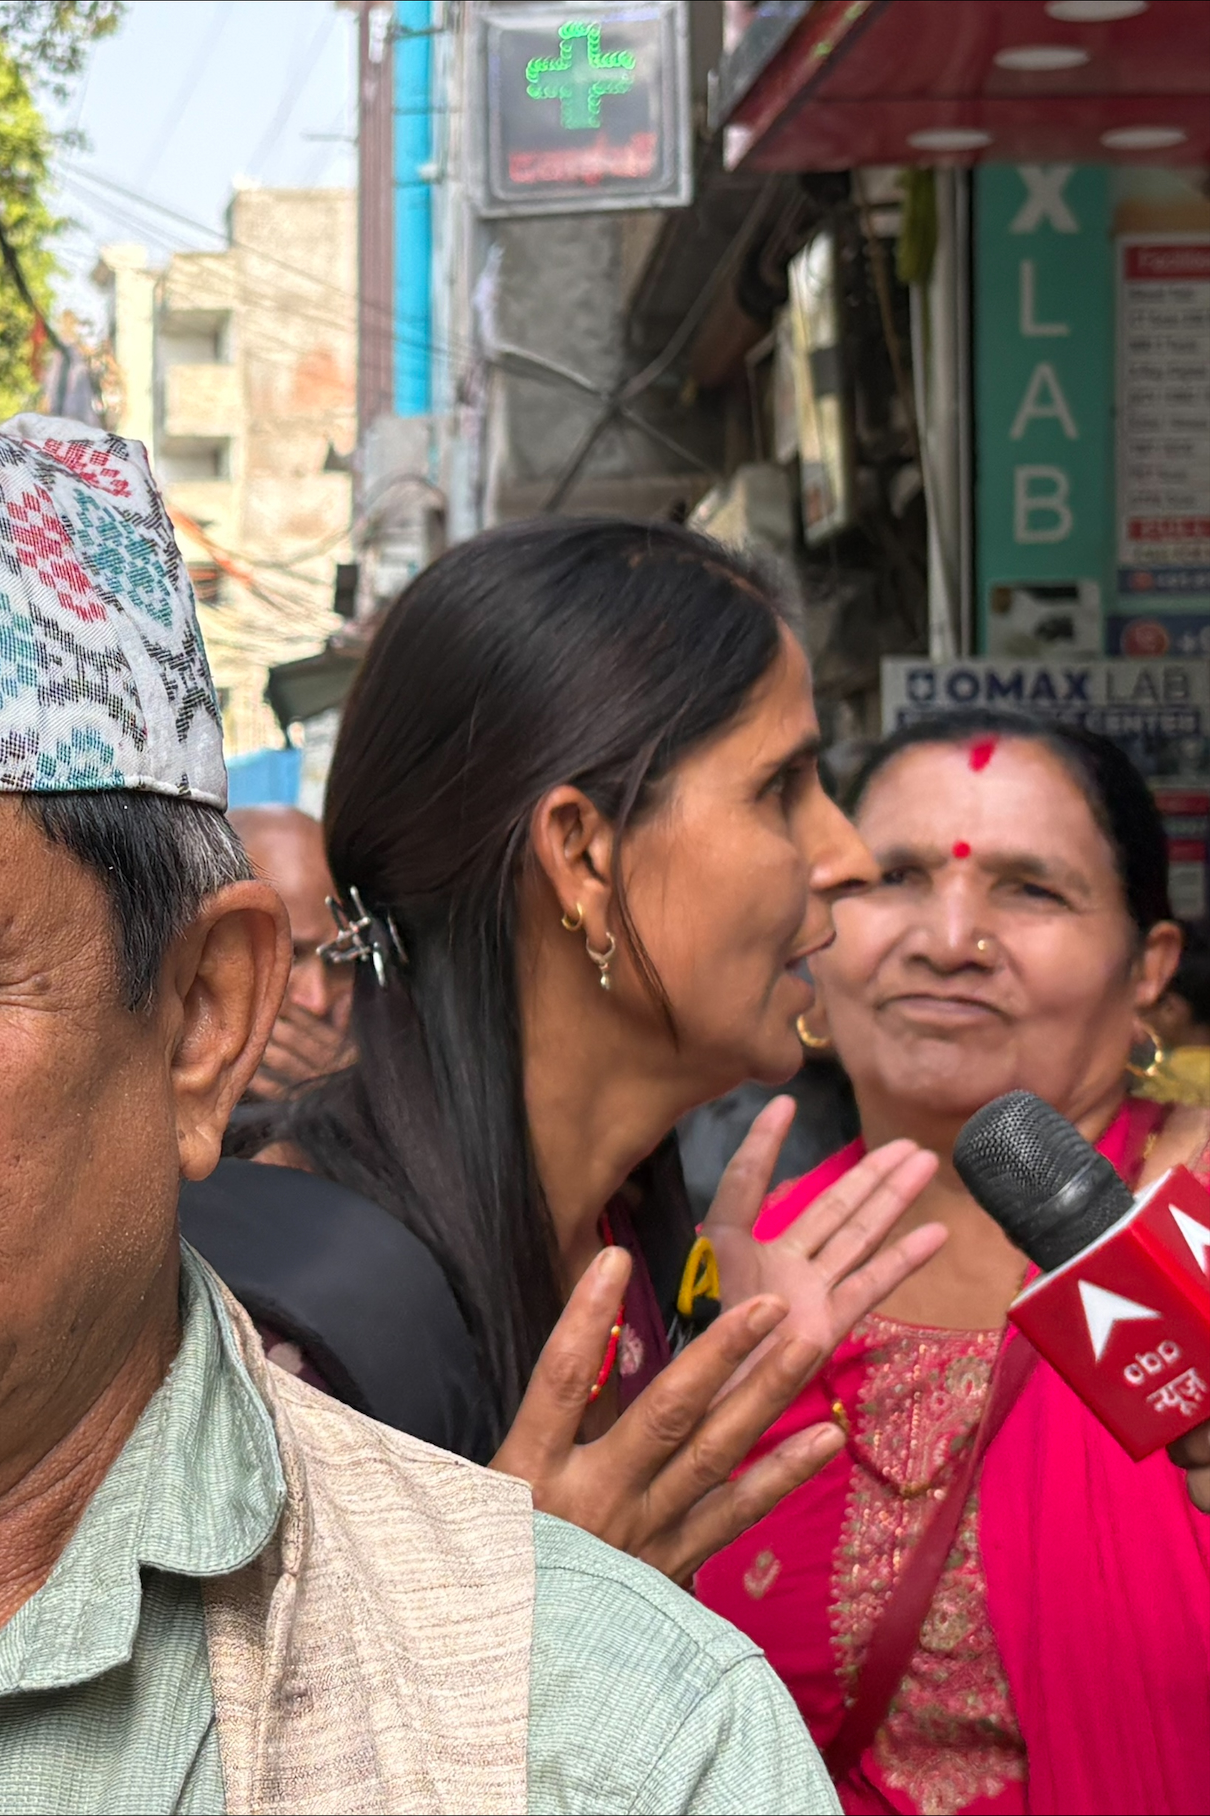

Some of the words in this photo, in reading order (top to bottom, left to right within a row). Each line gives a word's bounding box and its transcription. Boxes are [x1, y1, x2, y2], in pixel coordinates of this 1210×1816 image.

[1008, 258, 1080, 544] LAB
[944, 669, 1091, 702] OMAX
[1106, 668, 1190, 701] LAB
